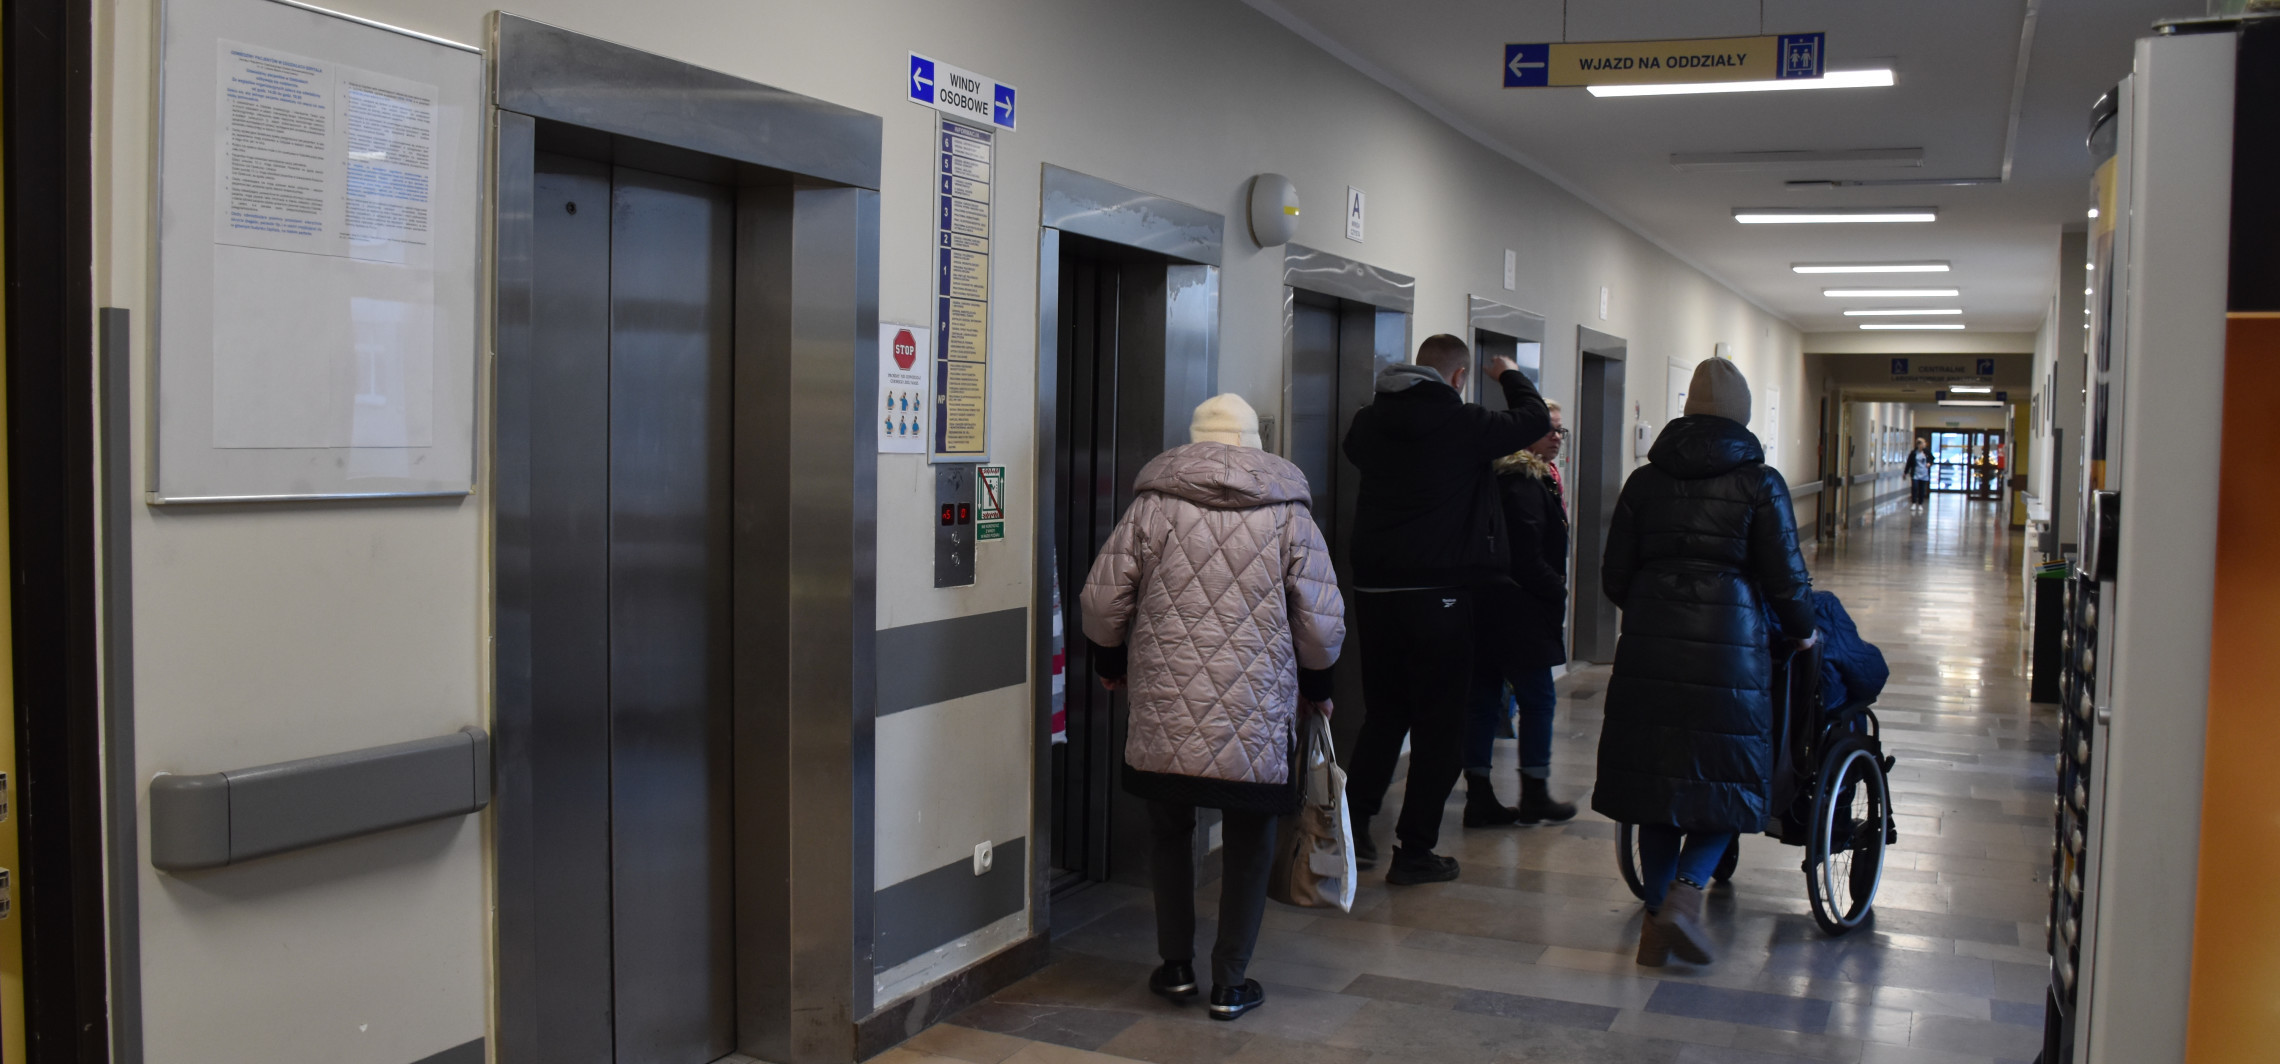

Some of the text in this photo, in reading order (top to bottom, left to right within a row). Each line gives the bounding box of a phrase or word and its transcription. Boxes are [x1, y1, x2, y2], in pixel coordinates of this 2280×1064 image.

[1579, 54, 1747, 70] WJAZD NA ODDZIAŁY
[950, 73, 980, 95] WINDY
[940, 88, 989, 116] OSOBOWE
[954, 126, 980, 138] INFORMACJA
[945, 138, 949, 148] 6
[945, 159, 948, 168] 5
[944, 180, 948, 190] 4
[1352, 193, 1360, 219] A
[944, 207, 948, 217] 3
[944, 234, 948, 244] 2
[944, 266, 947, 276] 1
[942, 322, 946, 331] P
[895, 344, 914, 356] STOP
[938, 394, 946, 404] NP
